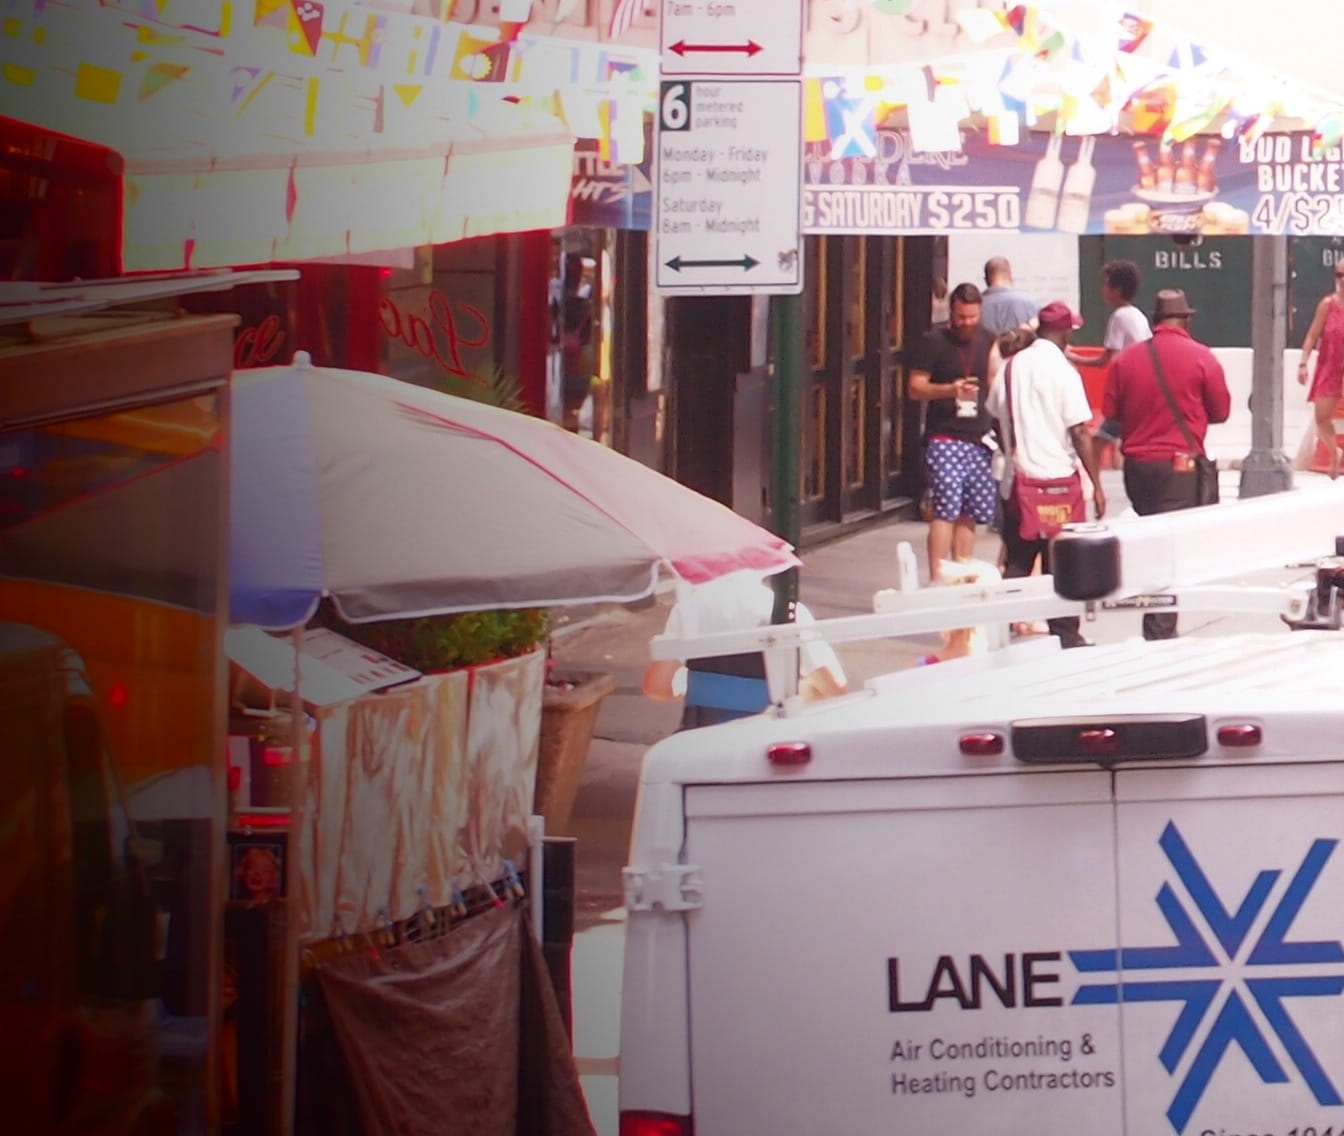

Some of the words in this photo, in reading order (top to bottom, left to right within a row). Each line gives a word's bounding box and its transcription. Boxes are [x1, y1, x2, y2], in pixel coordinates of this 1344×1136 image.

[667, 0, 694, 17] 7am
[706, 1, 736, 19] 6pm
[661, 83, 688, 129] 6
[695, 101, 744, 113] metered
[695, 115, 738, 130] parking
[662, 146, 714, 163] Monday
[728, 146, 769, 164] Friday
[1238, 134, 1291, 163] BUD
[706, 167, 761, 185] Midnight
[662, 198, 723, 214] Saturday
[818, 191, 923, 229] SATURDAY
[927, 189, 1020, 231] $250
[705, 218, 761, 236] Midnight
[1154, 250, 1222, 269] BILLS
[887, 950, 1064, 1013] LANE
[889, 1038, 923, 1062] Air
[929, 1036, 1072, 1062] Conditioning
[1081, 1034, 1097, 1056] &
[890, 1071, 978, 1098] Heating
[983, 1067, 1117, 1093] Contractors
